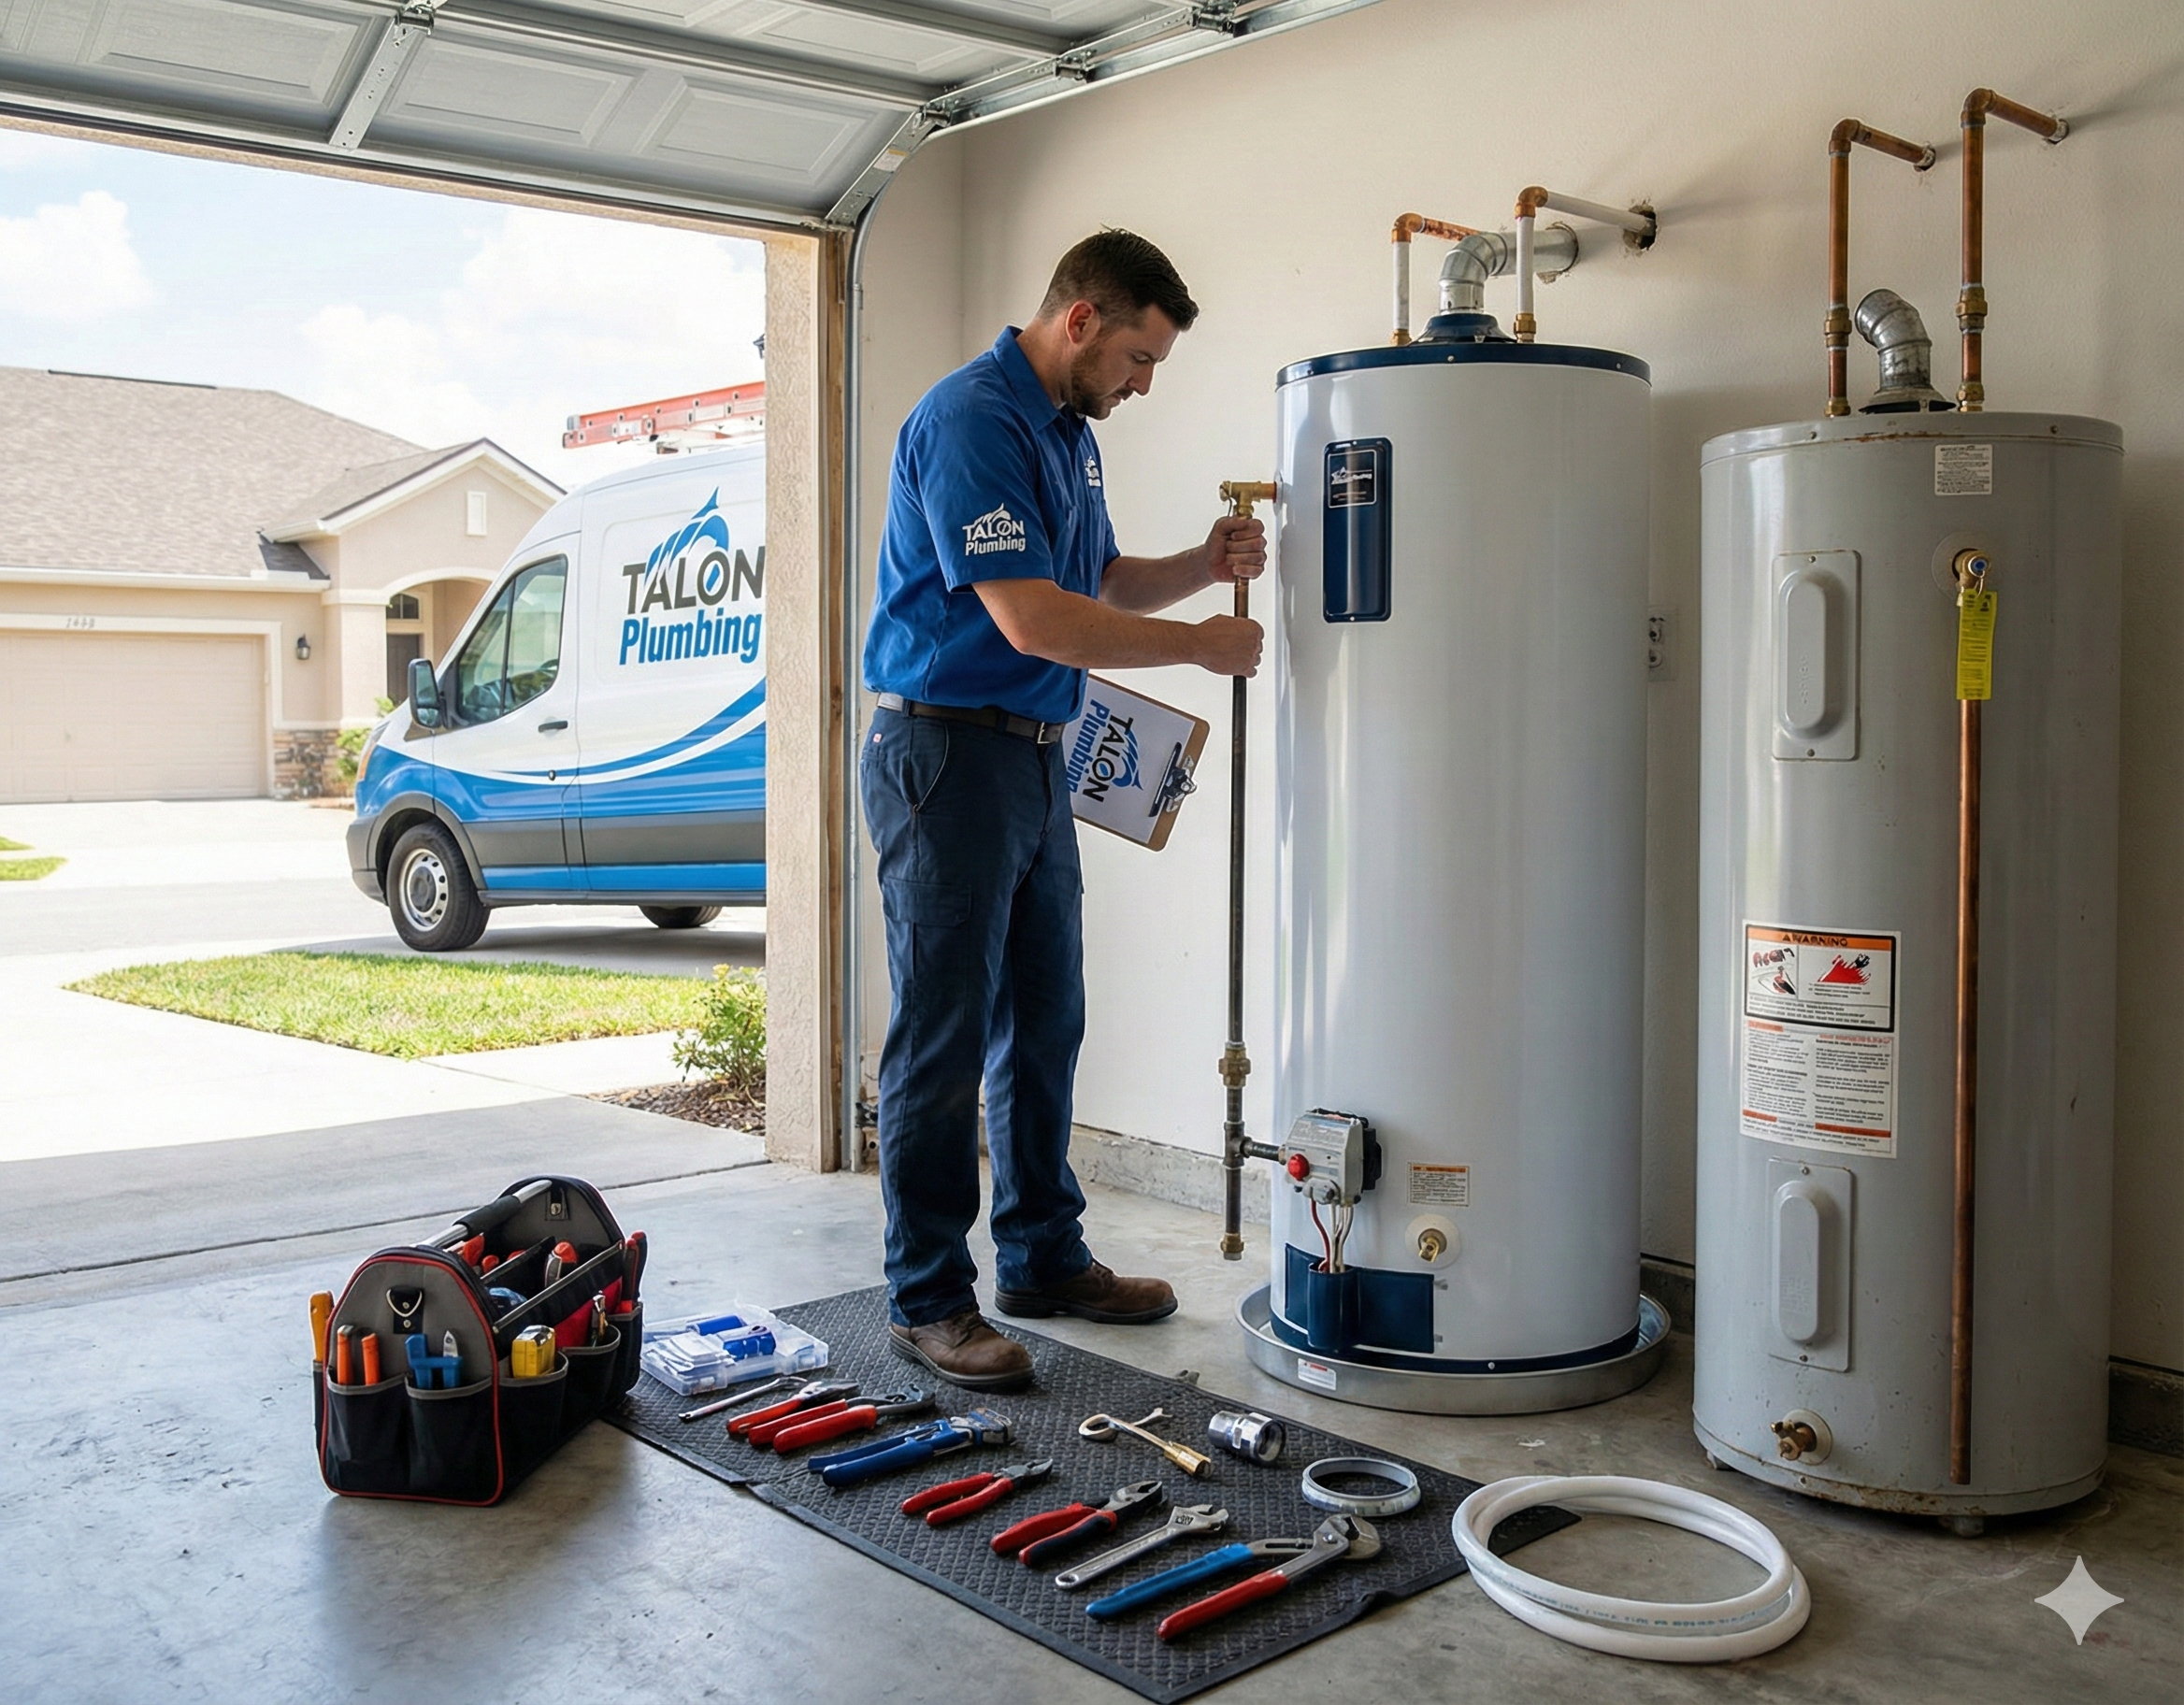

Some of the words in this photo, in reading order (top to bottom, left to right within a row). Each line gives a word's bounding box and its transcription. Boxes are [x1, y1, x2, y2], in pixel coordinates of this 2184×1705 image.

[961, 520, 1026, 542] TALON
[965, 536, 1027, 556] Plumbing
[622, 545, 767, 615] TALON
[619, 607, 763, 666] Plumbing
[1082, 715, 1134, 803] TALON
